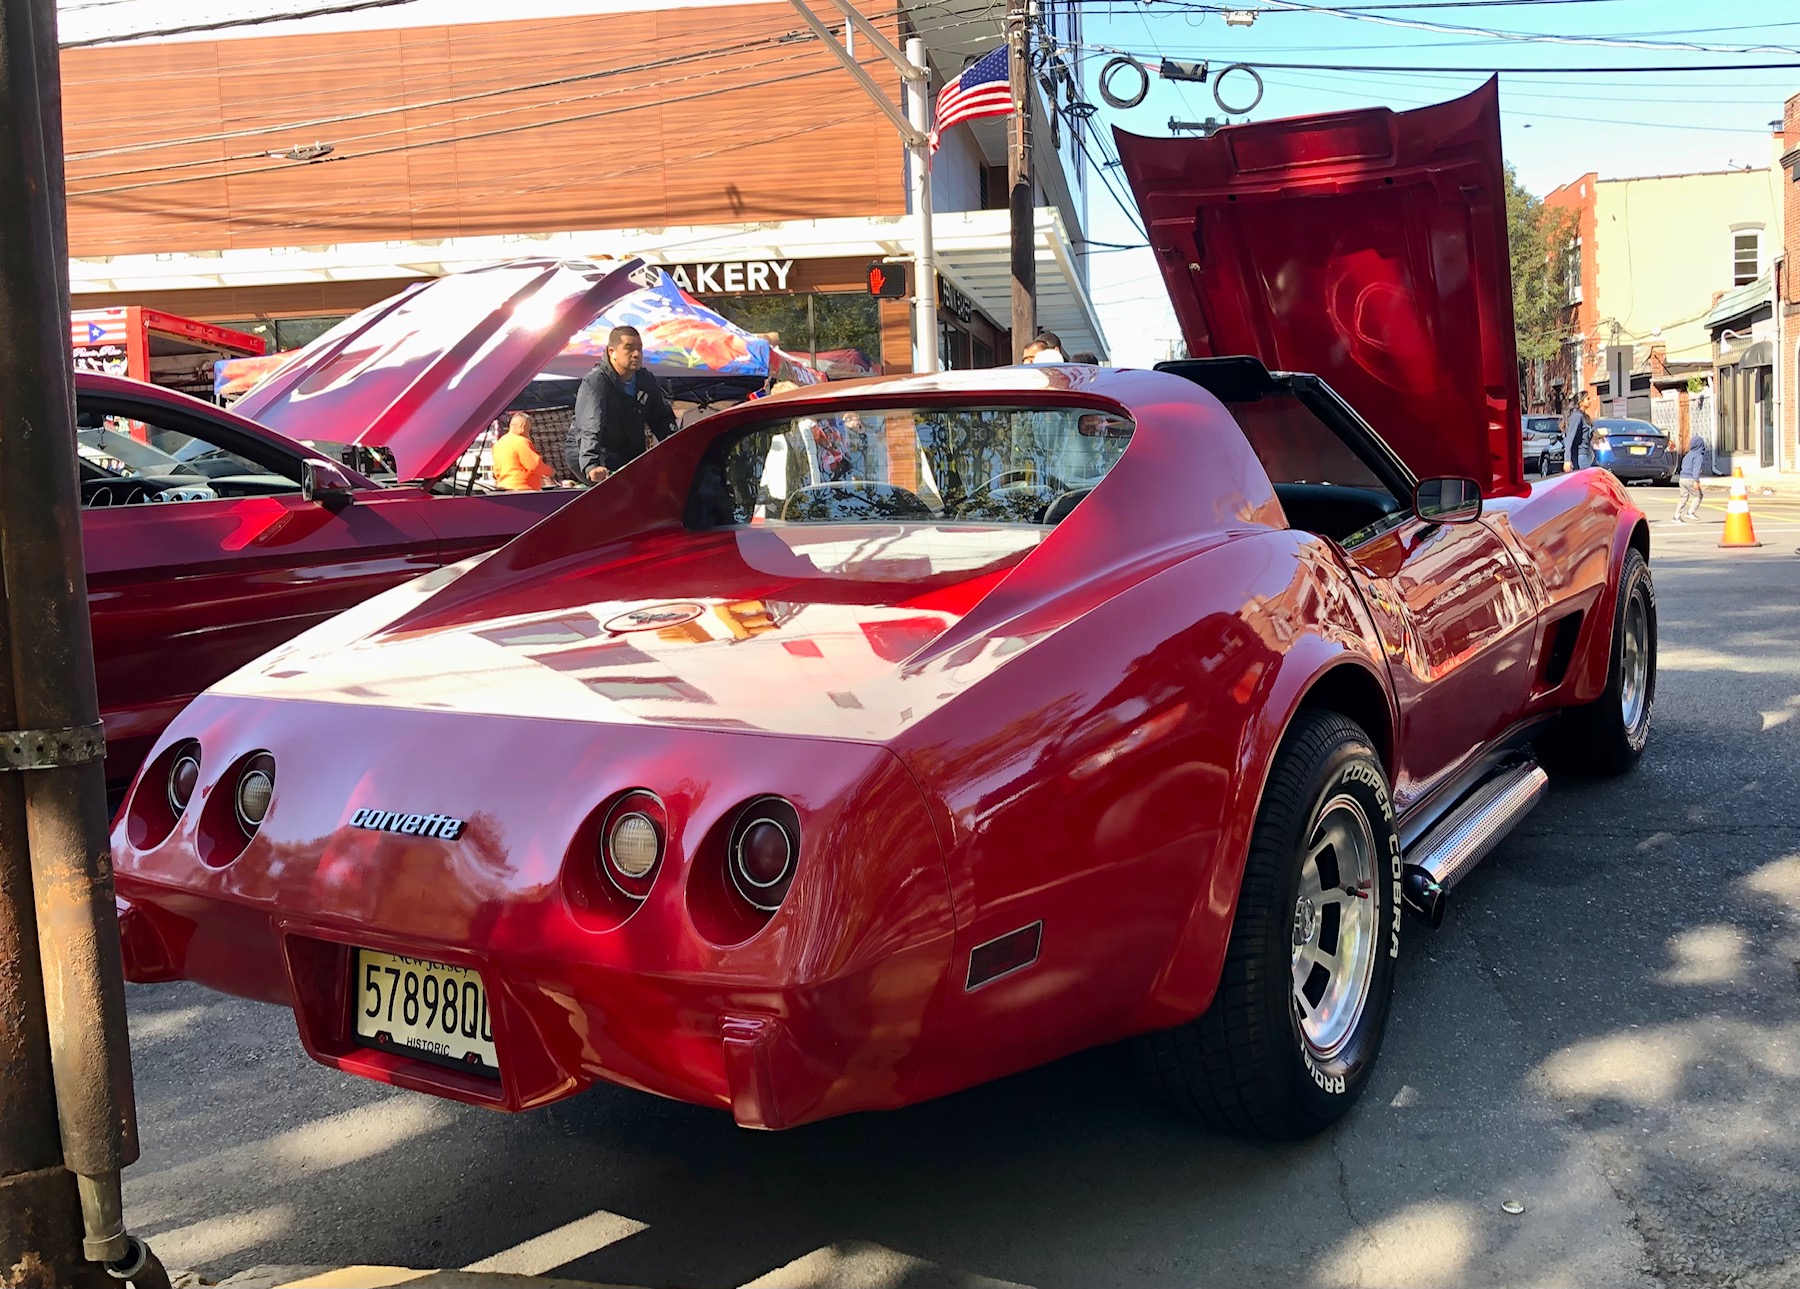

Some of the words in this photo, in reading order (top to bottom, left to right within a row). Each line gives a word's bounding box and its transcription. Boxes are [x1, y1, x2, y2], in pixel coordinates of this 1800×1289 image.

[656, 260, 794, 293] AKERY
[349, 808, 466, 840] corvette
[1341, 765, 1393, 823] COOPER
[1388, 833, 1402, 959] COBRA
[406, 1036, 451, 1056] HISTORIC
